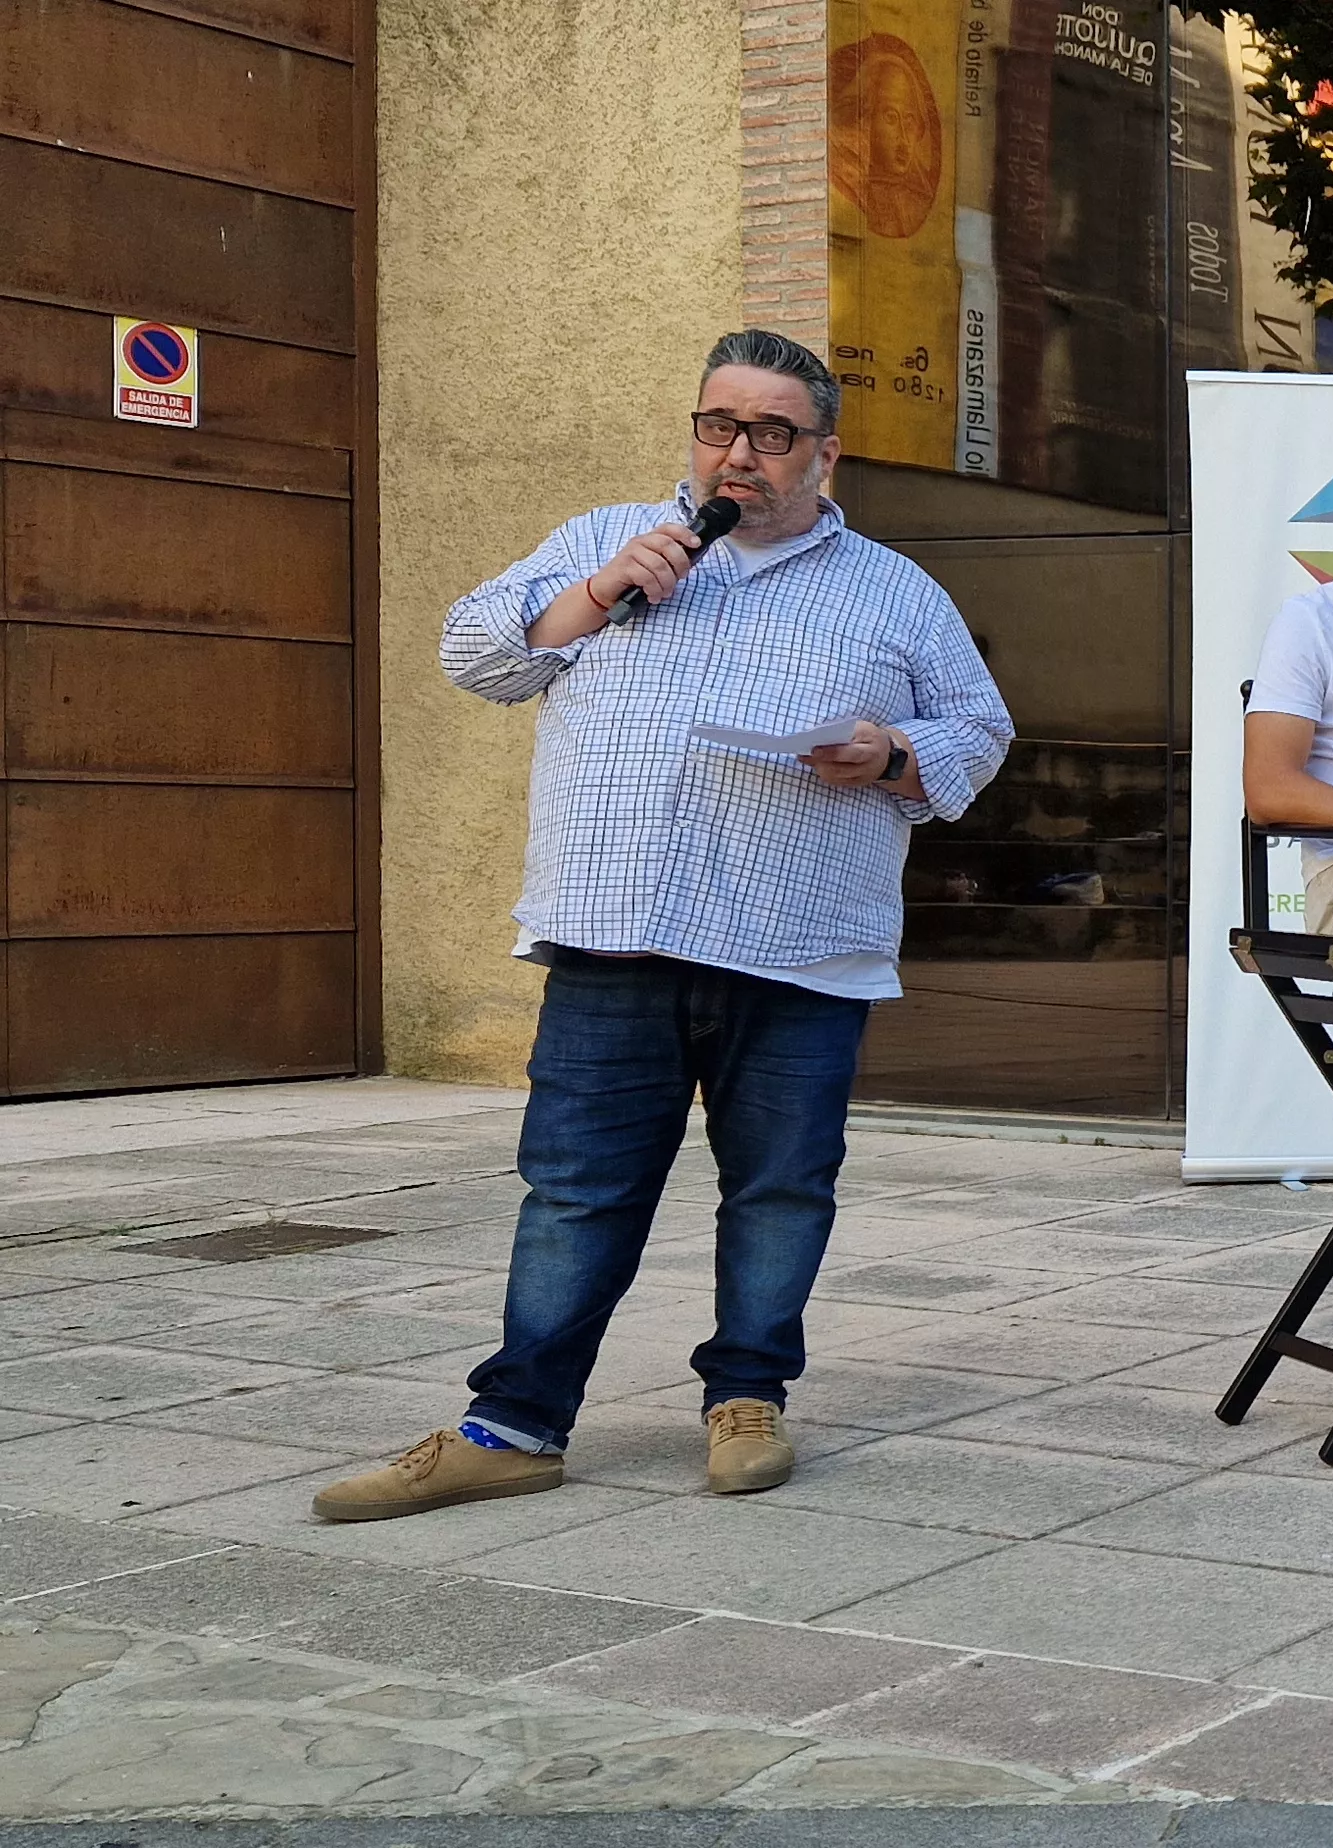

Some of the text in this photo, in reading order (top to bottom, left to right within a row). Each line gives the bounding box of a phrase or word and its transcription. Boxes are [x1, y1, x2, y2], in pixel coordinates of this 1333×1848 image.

[128, 390, 184, 408] SALIDA DE
[121, 402, 191, 421] EMERGENCIA
